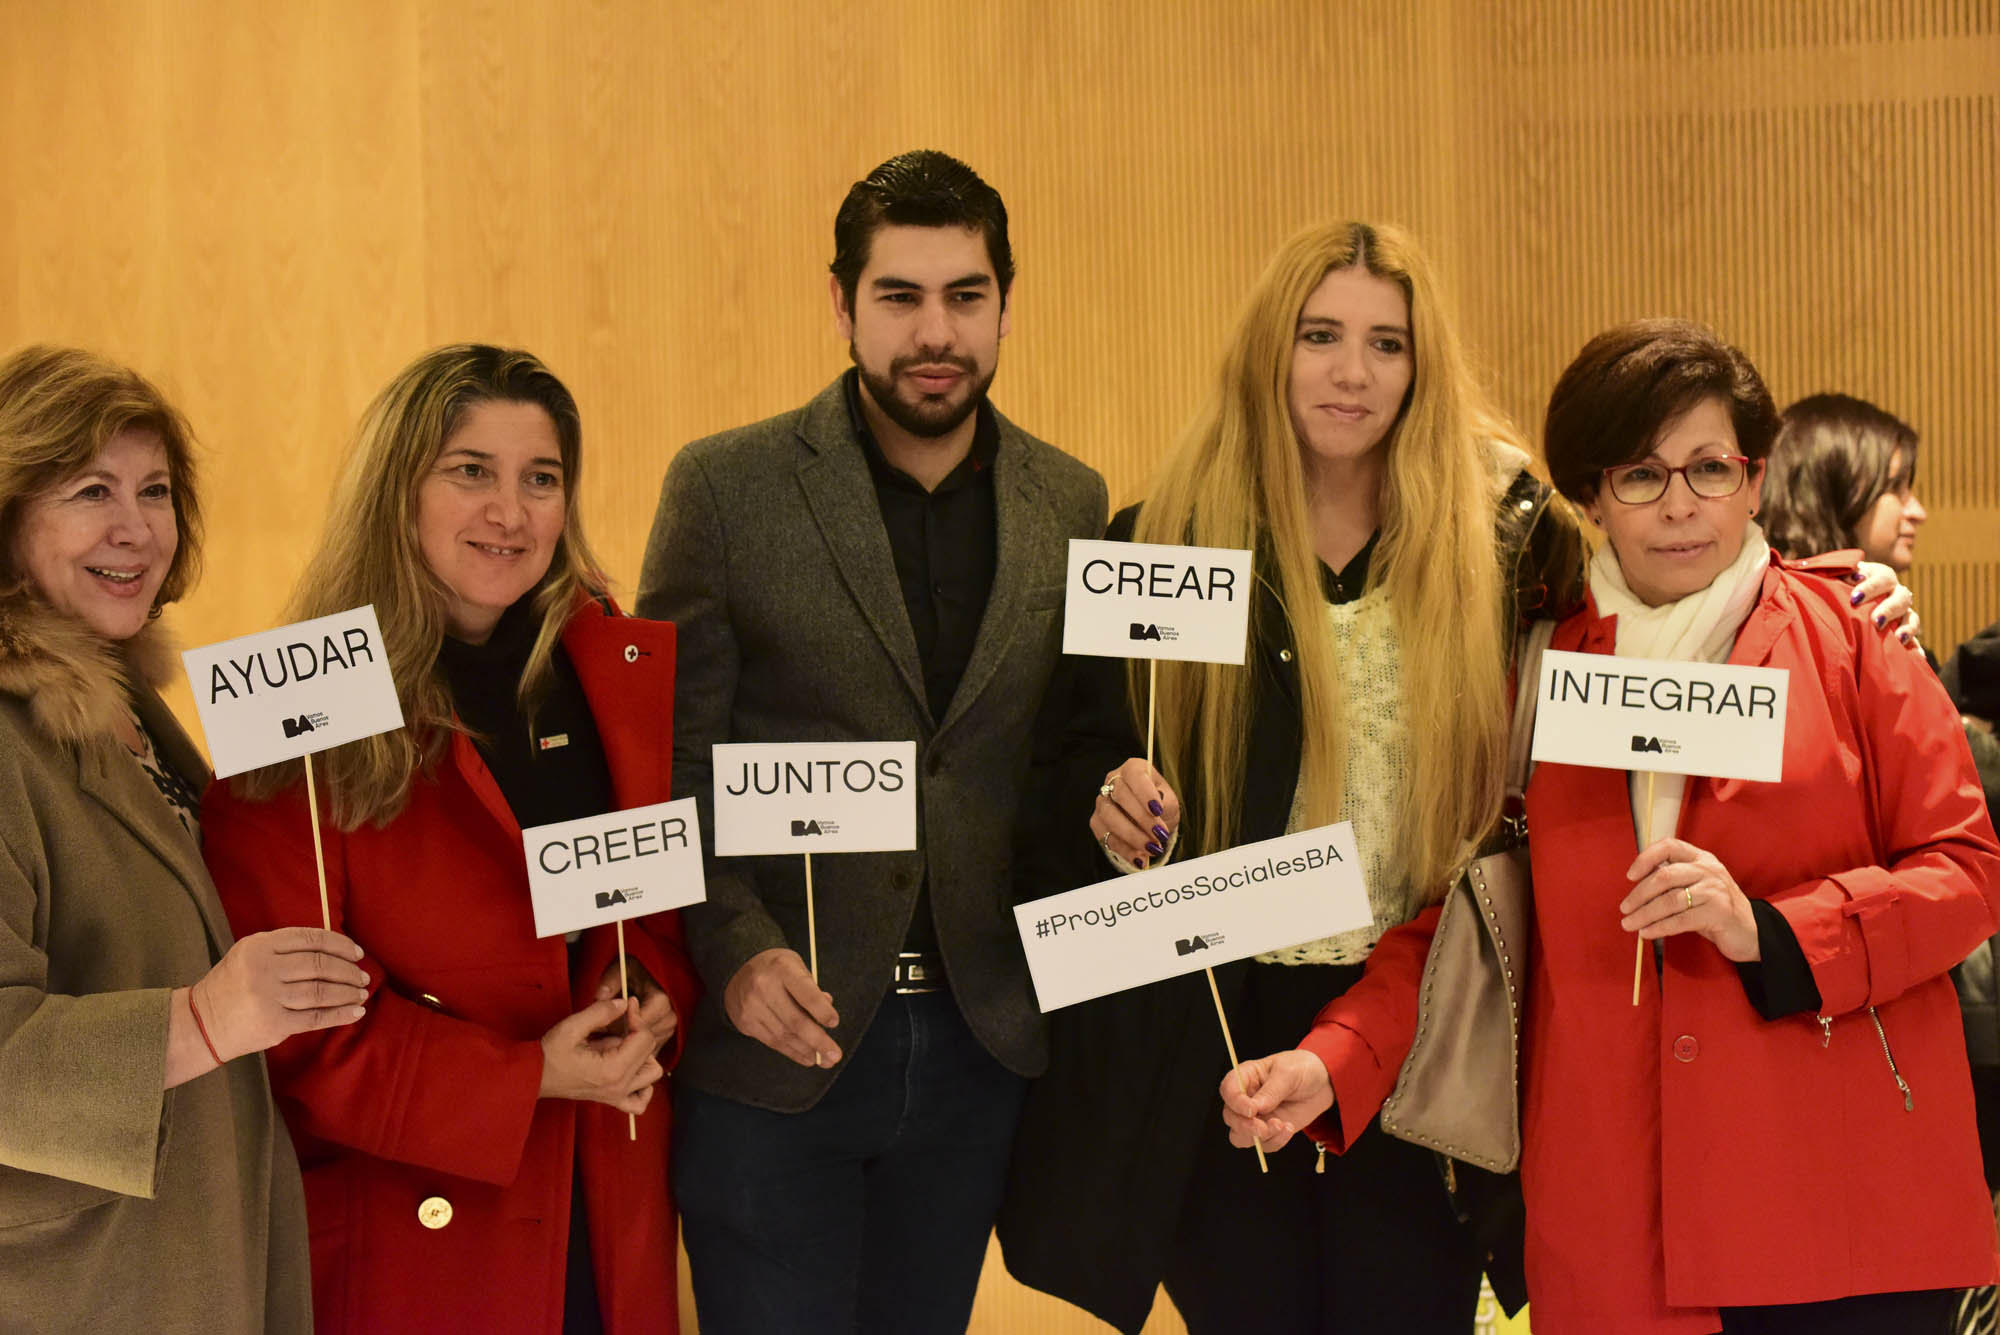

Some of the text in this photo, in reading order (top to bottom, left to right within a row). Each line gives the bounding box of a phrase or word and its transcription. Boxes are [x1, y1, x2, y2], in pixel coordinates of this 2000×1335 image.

[1082, 559, 1235, 601] CREAR
[1130, 623, 1161, 641] BA
[211, 628, 374, 705] AYUDAR
[1549, 669, 1776, 719] INTEGRAR
[282, 714, 314, 738] BA
[1631, 735, 1662, 754] BA
[726, 759, 904, 796] JUNTOS
[791, 819, 822, 836] BA
[539, 817, 688, 875] CREER
[595, 889, 627, 909] BA
[1035, 843, 1344, 939] #ProyectosSocialesBA
[1175, 935, 1209, 956] BA
